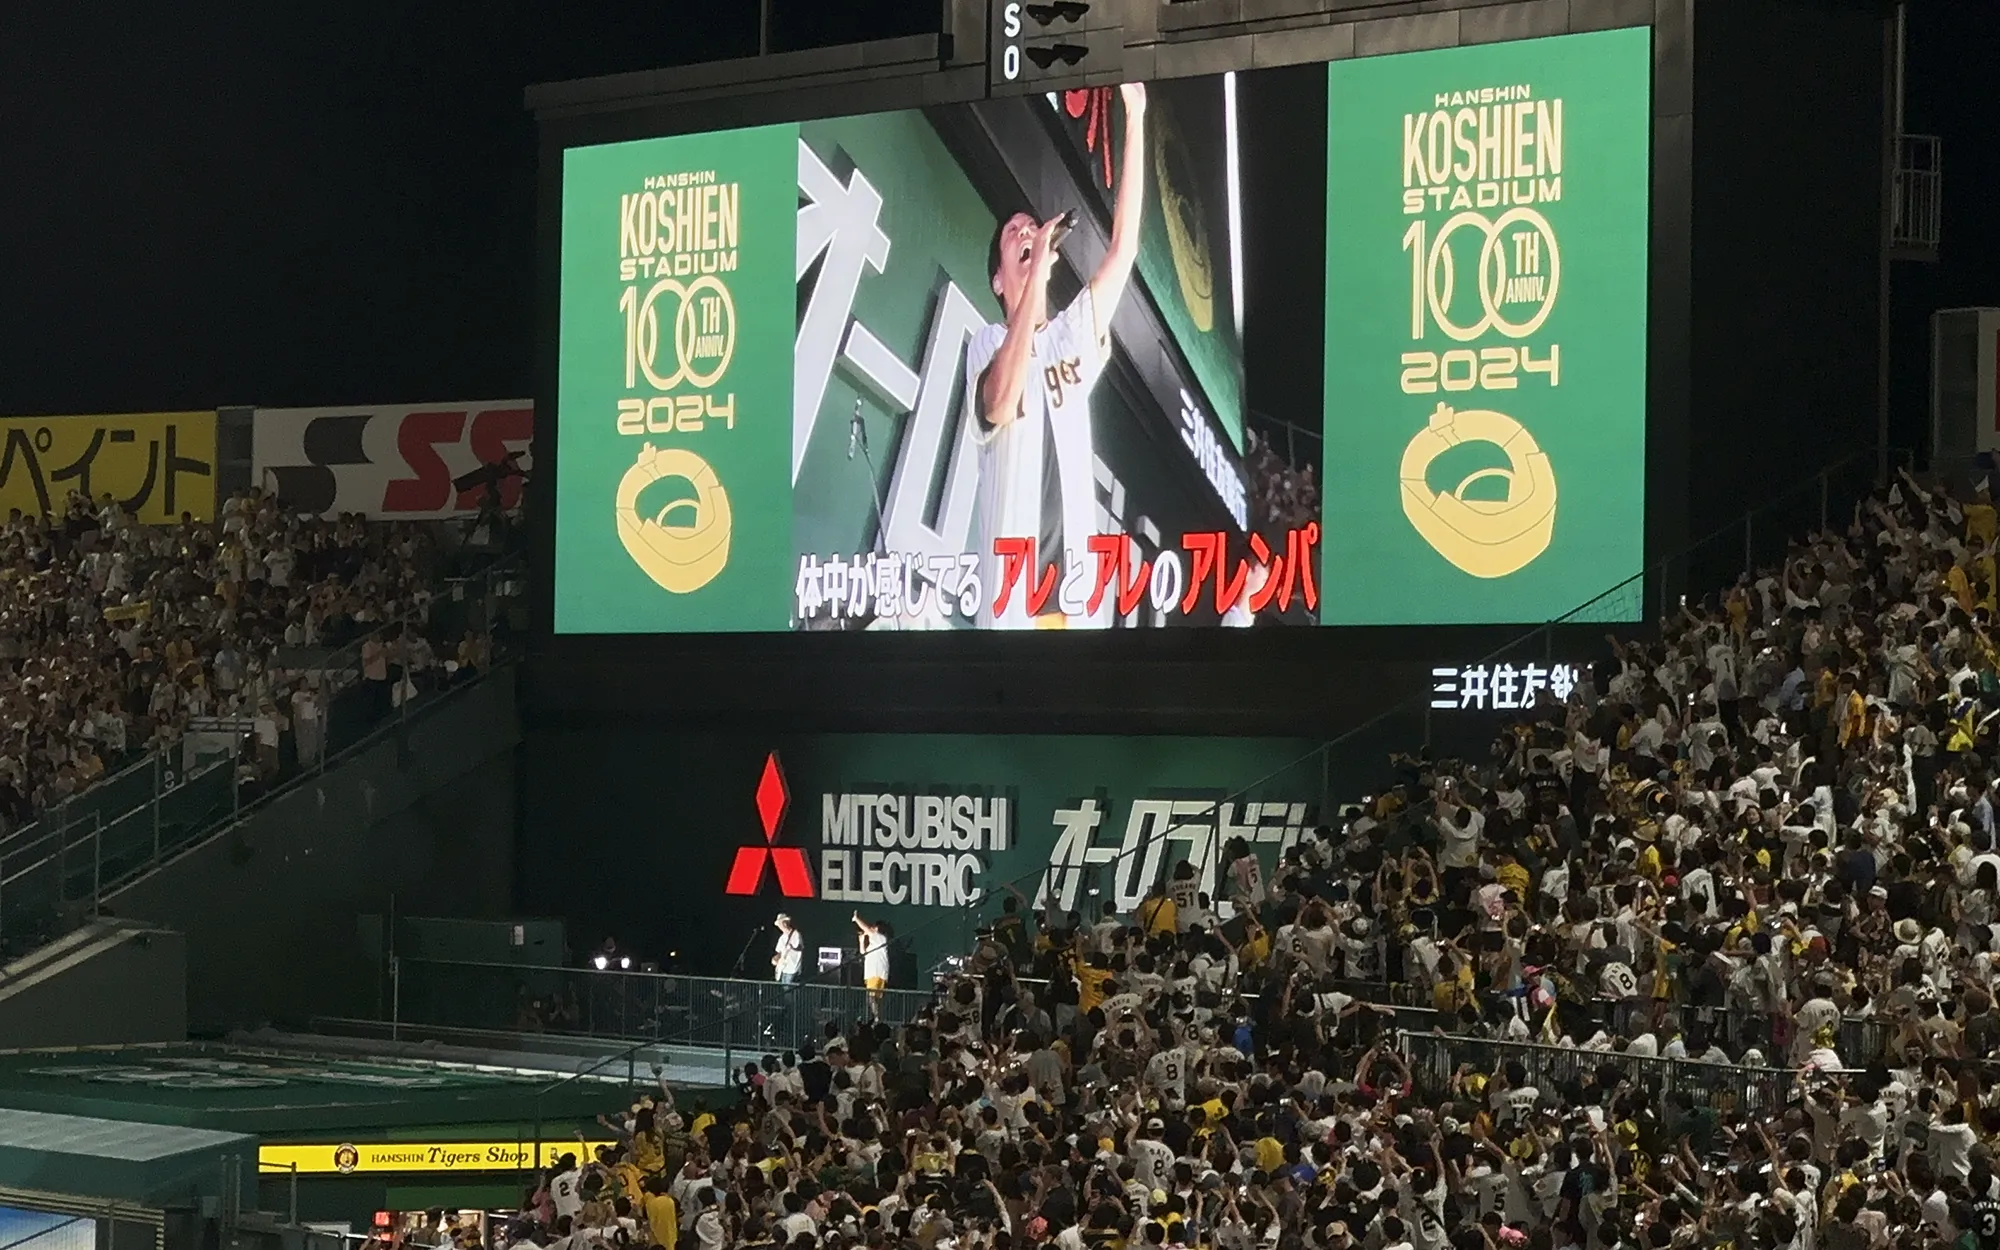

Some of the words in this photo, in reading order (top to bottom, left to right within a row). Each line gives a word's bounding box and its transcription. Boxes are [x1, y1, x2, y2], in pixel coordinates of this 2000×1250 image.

[1004, 3, 1021, 38] S
[1435, 83, 1530, 108] HANSHIN
[1403, 99, 1563, 187] KOSHIEN
[644, 170, 715, 190] HANSHIN
[1403, 177, 1562, 214] STADIUM
[620, 183, 738, 258] KOSHIEN
[620, 250, 737, 281] STADIUM
[1402, 207, 1561, 342] 100
[1512, 231, 1540, 275] TH
[620, 275, 736, 391] 100
[700, 296, 721, 334] TH
[1400, 344, 1560, 394] 2024
[616, 393, 734, 435] 2024
[822, 793, 1007, 851] MITSUBISHI
[821, 849, 981, 907] ELECTRIC
[1619, 972, 1634, 990] 8
[1188, 1023, 1199, 1041] 8
[1166, 1063, 1178, 1081] 8
[371, 1152, 425, 1164] HANSHIN
[427, 1146, 481, 1168] Tigers
[486, 1146, 529, 1168] Shop
[1153, 1159, 1164, 1177] 8
[559, 1181, 570, 1197] 2
[1981, 1213, 1998, 1236] 3
